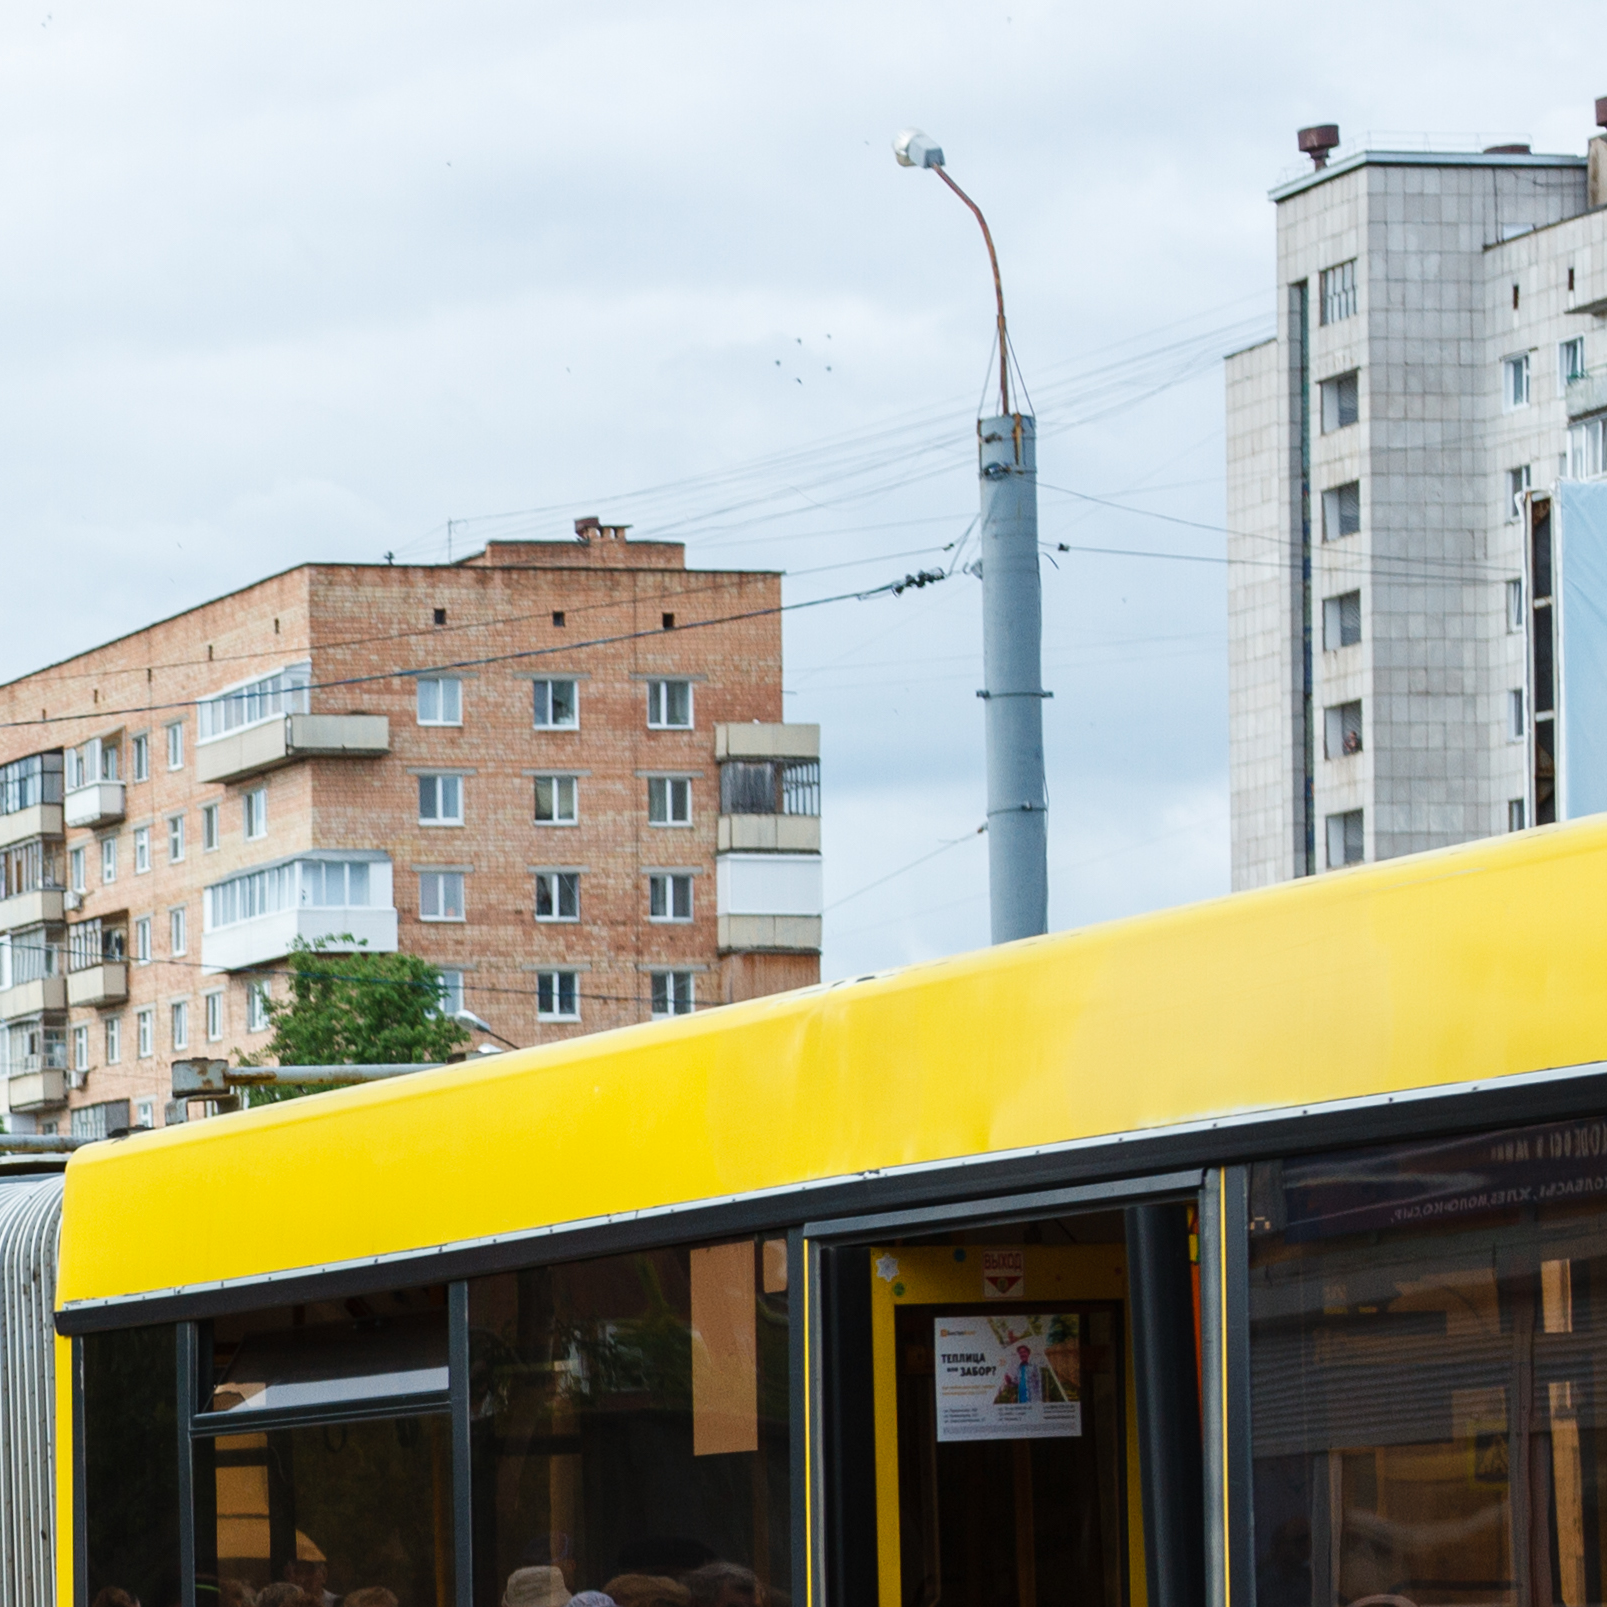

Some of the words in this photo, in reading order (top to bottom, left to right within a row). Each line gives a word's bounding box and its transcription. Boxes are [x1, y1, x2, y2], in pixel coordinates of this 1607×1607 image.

[984, 1253, 1021, 1270] ВЫХОД
[941, 1353, 986, 1365] ТЕПЛИЦА
[960, 1366, 997, 1377] ЗАБОР?
